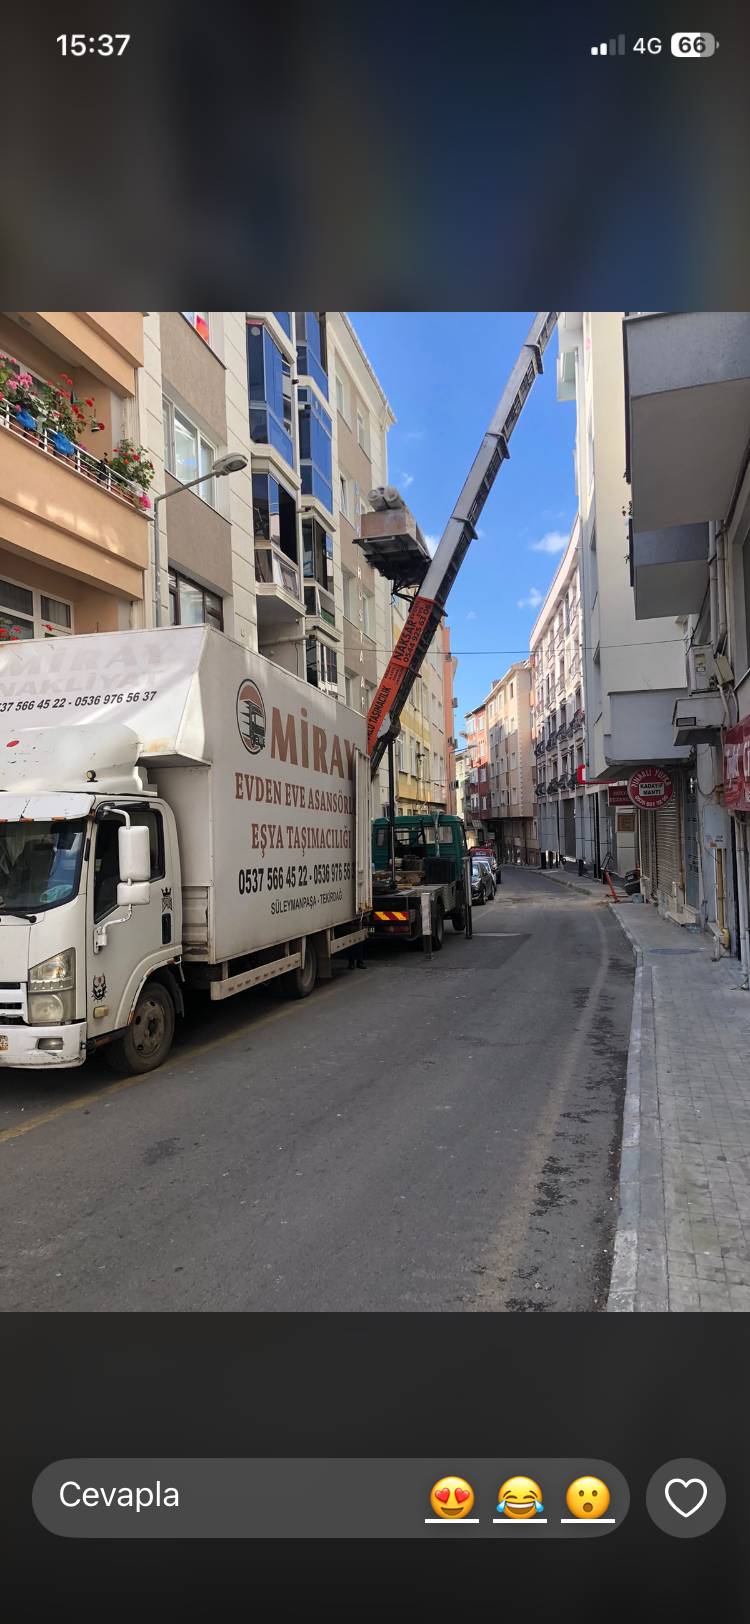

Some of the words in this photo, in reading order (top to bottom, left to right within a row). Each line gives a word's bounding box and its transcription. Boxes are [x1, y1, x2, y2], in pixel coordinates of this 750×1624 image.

[15, 700, 35, 712] 566
[36, 699, 50, 710] 45
[52, 697, 66, 709] 22
[74, 695, 101, 707] 0536
[103, 693, 124, 704] 976
[125, 692, 140, 703] 56
[142, 690, 157, 702] 37
[271, 706, 356, 781] MİRAY
[234, 772, 282, 805] EVDEN
[285, 783, 306, 809] EVE
[308, 788, 356, 817] ASANSÖRL
[251, 823, 285, 858] EŞYA
[286, 825, 352, 857] TAŞIMACILIĞI
[238, 868, 264, 895] 0537
[267, 867, 284, 891] 566
[286, 866, 296, 888] 45
[298, 865, 308, 887] 22
[313, 864, 330, 885] 0536
[270, 895, 317, 915] SÜLEYMANPAŞA
